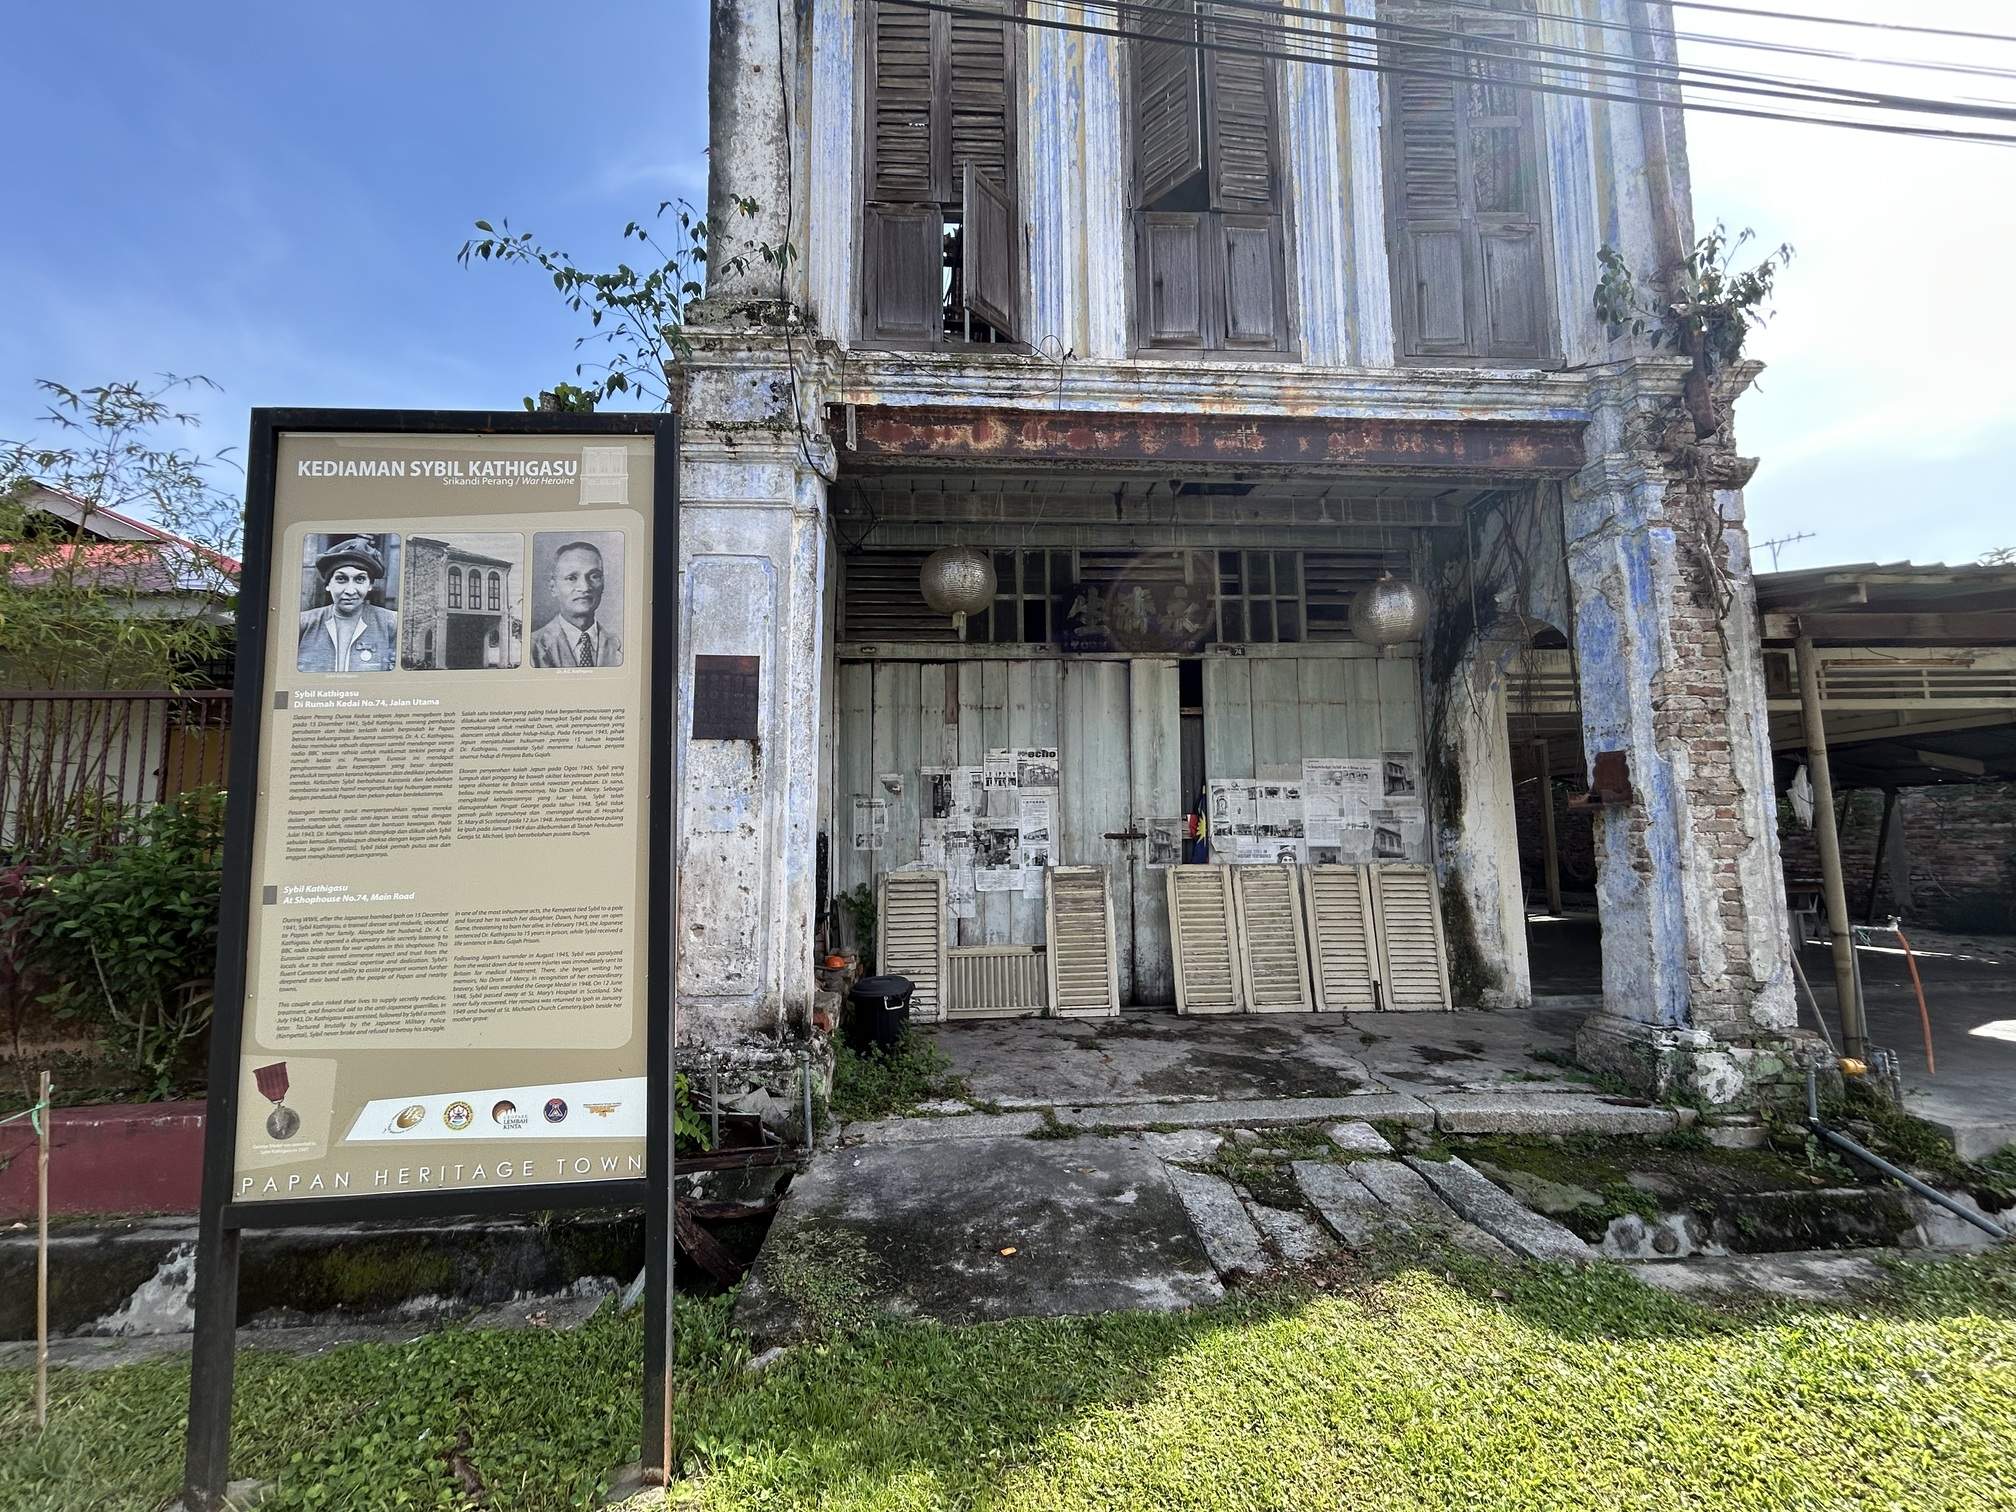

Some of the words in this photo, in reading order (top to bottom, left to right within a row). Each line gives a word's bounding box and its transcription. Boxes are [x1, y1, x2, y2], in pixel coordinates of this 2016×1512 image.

[298, 460, 405, 477] KEDIAMAN
[410, 460, 464, 477] SYBIL
[469, 460, 577, 477] KATHIGASU
[443, 476, 480, 486] Srikandi
[482, 476, 513, 487] Perang
[522, 476, 540, 485] War
[541, 476, 575, 485] Heroine
[294, 690, 315, 699] Sybil
[317, 690, 359, 699] Kathigasu
[305, 700, 335, 708] Rumah
[336, 700, 360, 708] Kedai
[1027, 750, 1056, 758] echo
[283, 886, 304, 895] Sybil
[305, 885, 349, 893] Kathigasu
[294, 895, 340, 905] Shophouse
[342, 894, 369, 902] No.74,
[370, 893, 392, 901] Main
[393, 892, 416, 900] Road
[241, 1171, 349, 1193] PAPAN
[375, 1160, 535, 1186] HERITAGE
[556, 1154, 642, 1175] TOWN
